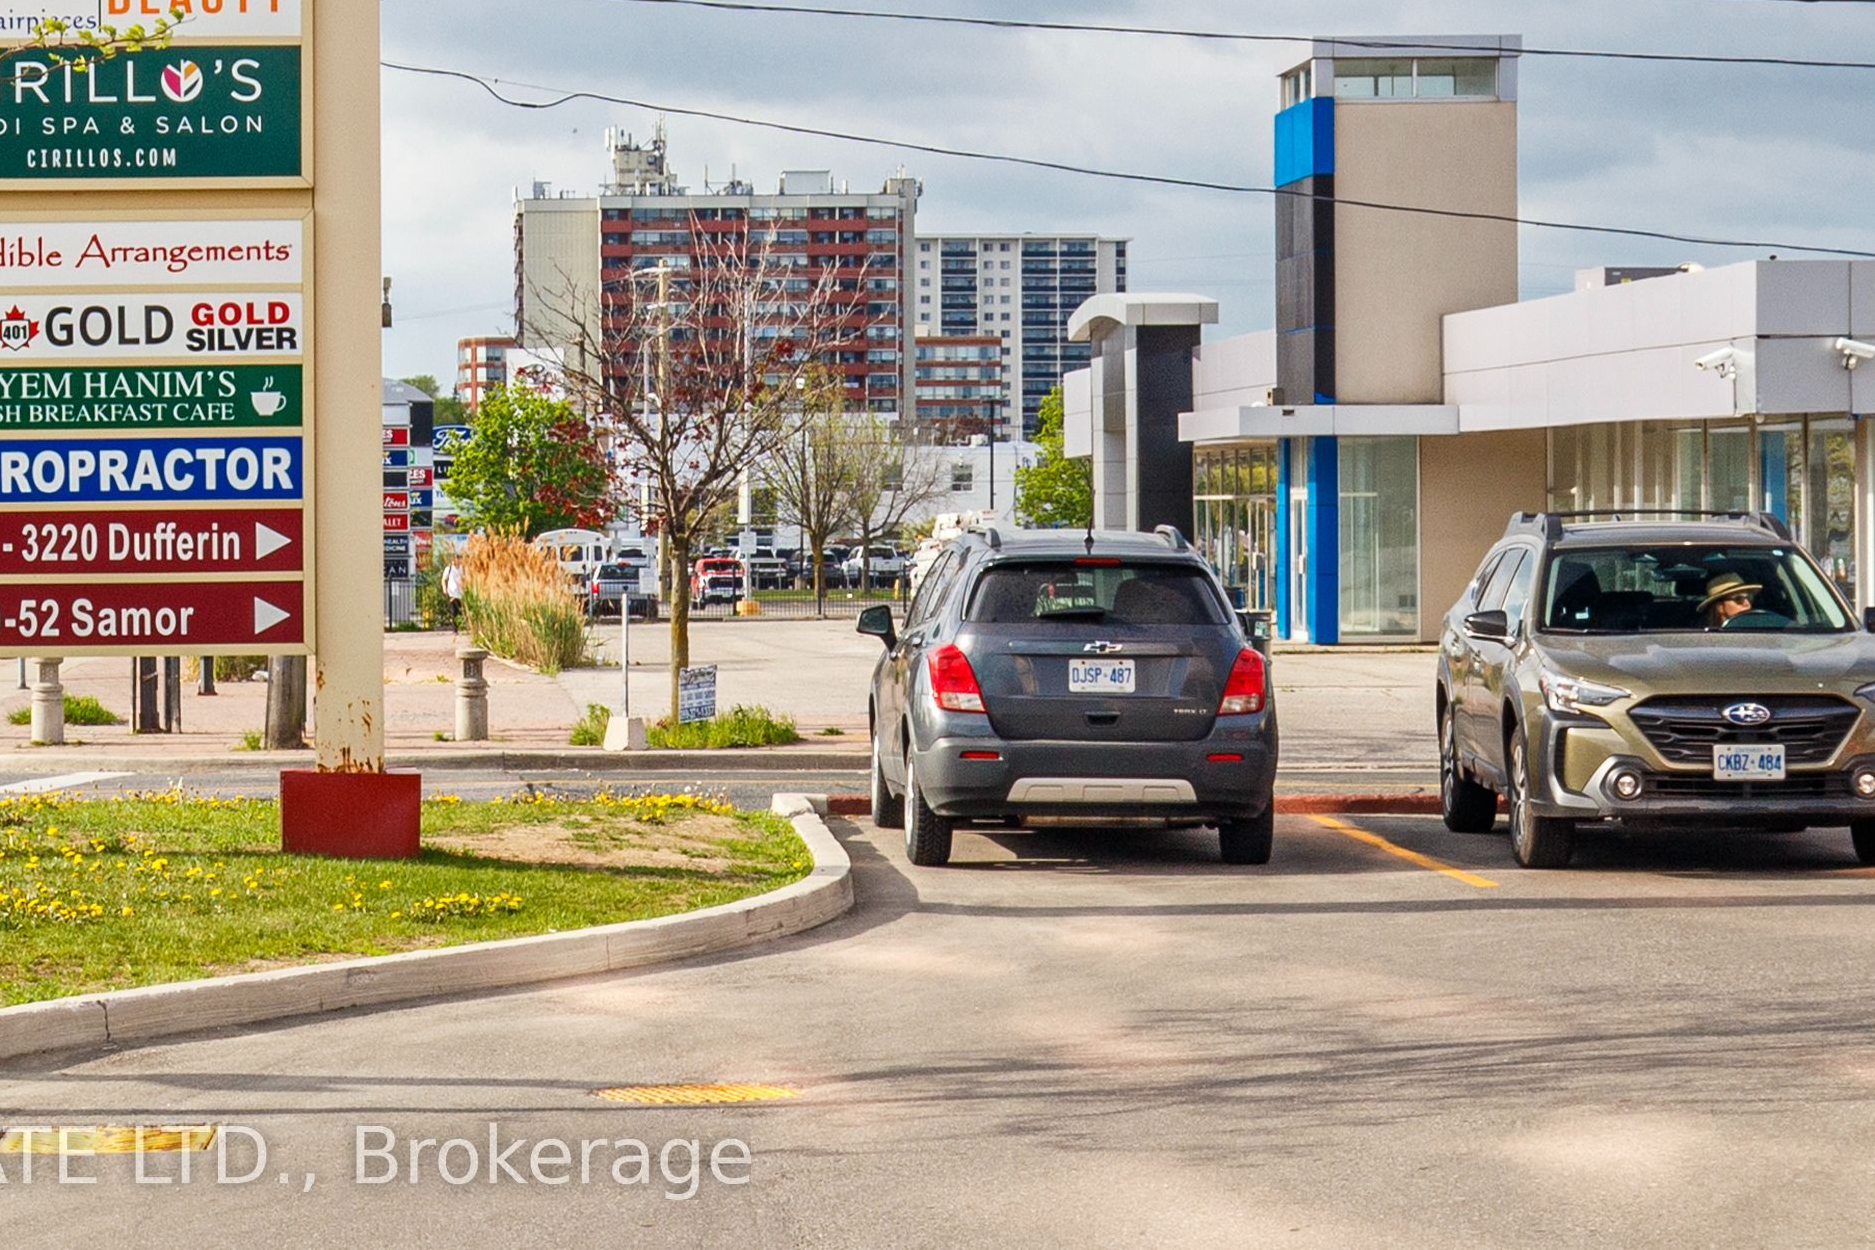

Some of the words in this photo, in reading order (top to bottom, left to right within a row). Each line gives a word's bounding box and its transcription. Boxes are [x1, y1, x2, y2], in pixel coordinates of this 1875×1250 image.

[42, 117, 100, 135] SPA
[119, 116, 136, 134] &
[156, 115, 263, 134] SALON
[26, 148, 177, 168] CIRILLOS.COM
[75, 234, 290, 272] Arrangements
[45, 304, 174, 347] GOLD
[191, 302, 290, 327] GOLD
[2, 325, 28, 340] 401
[186, 326, 298, 352] SILVER
[82, 370, 236, 399] HANIM'S
[28, 404, 168, 423] BREAKFAST
[172, 403, 236, 421] CAFE
[21, 523, 98, 562] 3220
[108, 522, 241, 561] Dufferin
[70, 597, 195, 637] Samor
[1110, 667, 1132, 683] 487
[1718, 753, 1749, 771] CKBZ
[1758, 753, 1782, 770] 484
